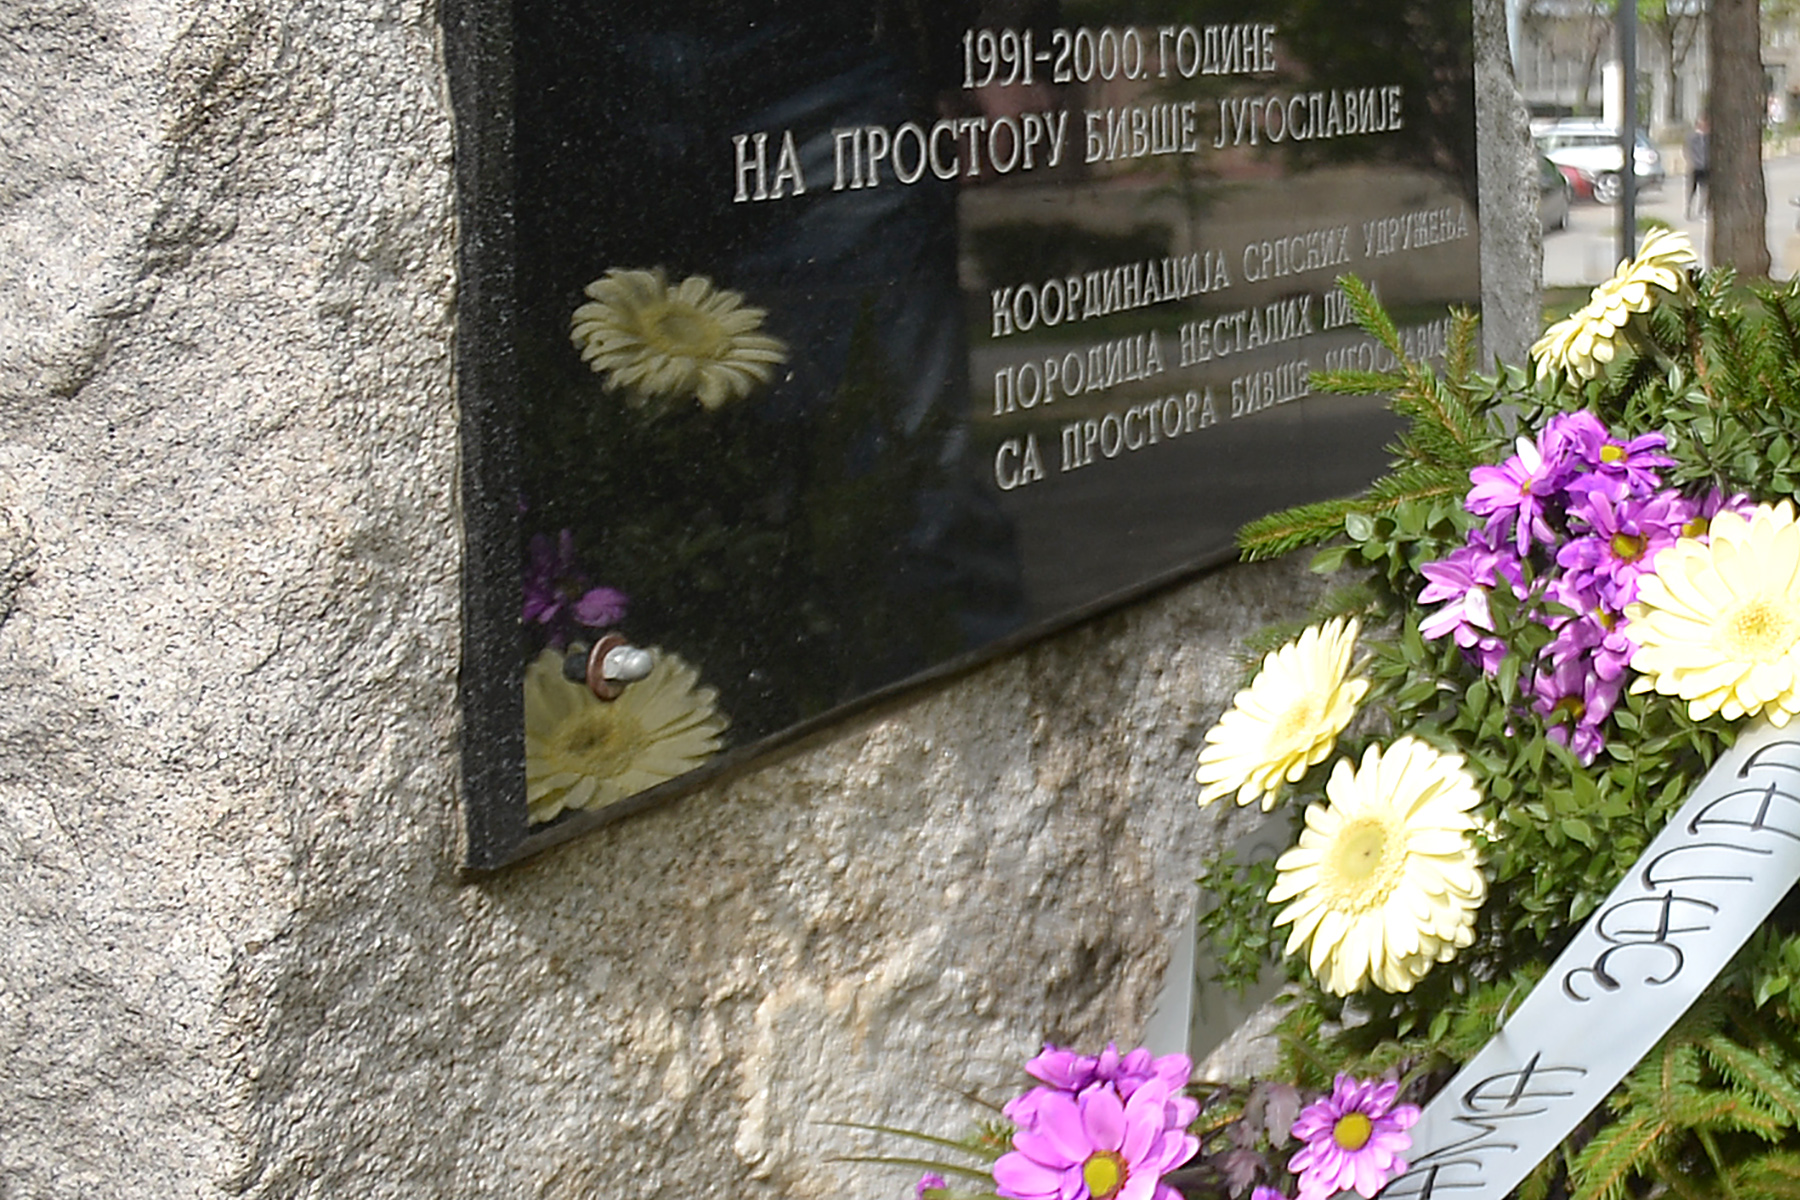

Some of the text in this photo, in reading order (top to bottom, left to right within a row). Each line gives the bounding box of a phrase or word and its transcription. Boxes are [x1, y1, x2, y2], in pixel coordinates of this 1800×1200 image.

[961, 23, 1277, 90] 1991-2000. ГОДИНЕ
[731, 83, 1405, 204] НА ПРОСТОРУ БИВШЕ ЈУГОСЛАВИЈЕ
[991, 202, 1469, 339] КООРДИНАЦИЈА СРПСКИХ УДРУЖЕЊА
[993, 335, 1165, 417] ПОРОДИЦА
[1179, 296, 1315, 369] НЕСТАЛИХ
[995, 432, 1046, 492] СА
[1061, 386, 1218, 473] ПРОСТОРА
[1230, 358, 1310, 419] БИВШЕ
